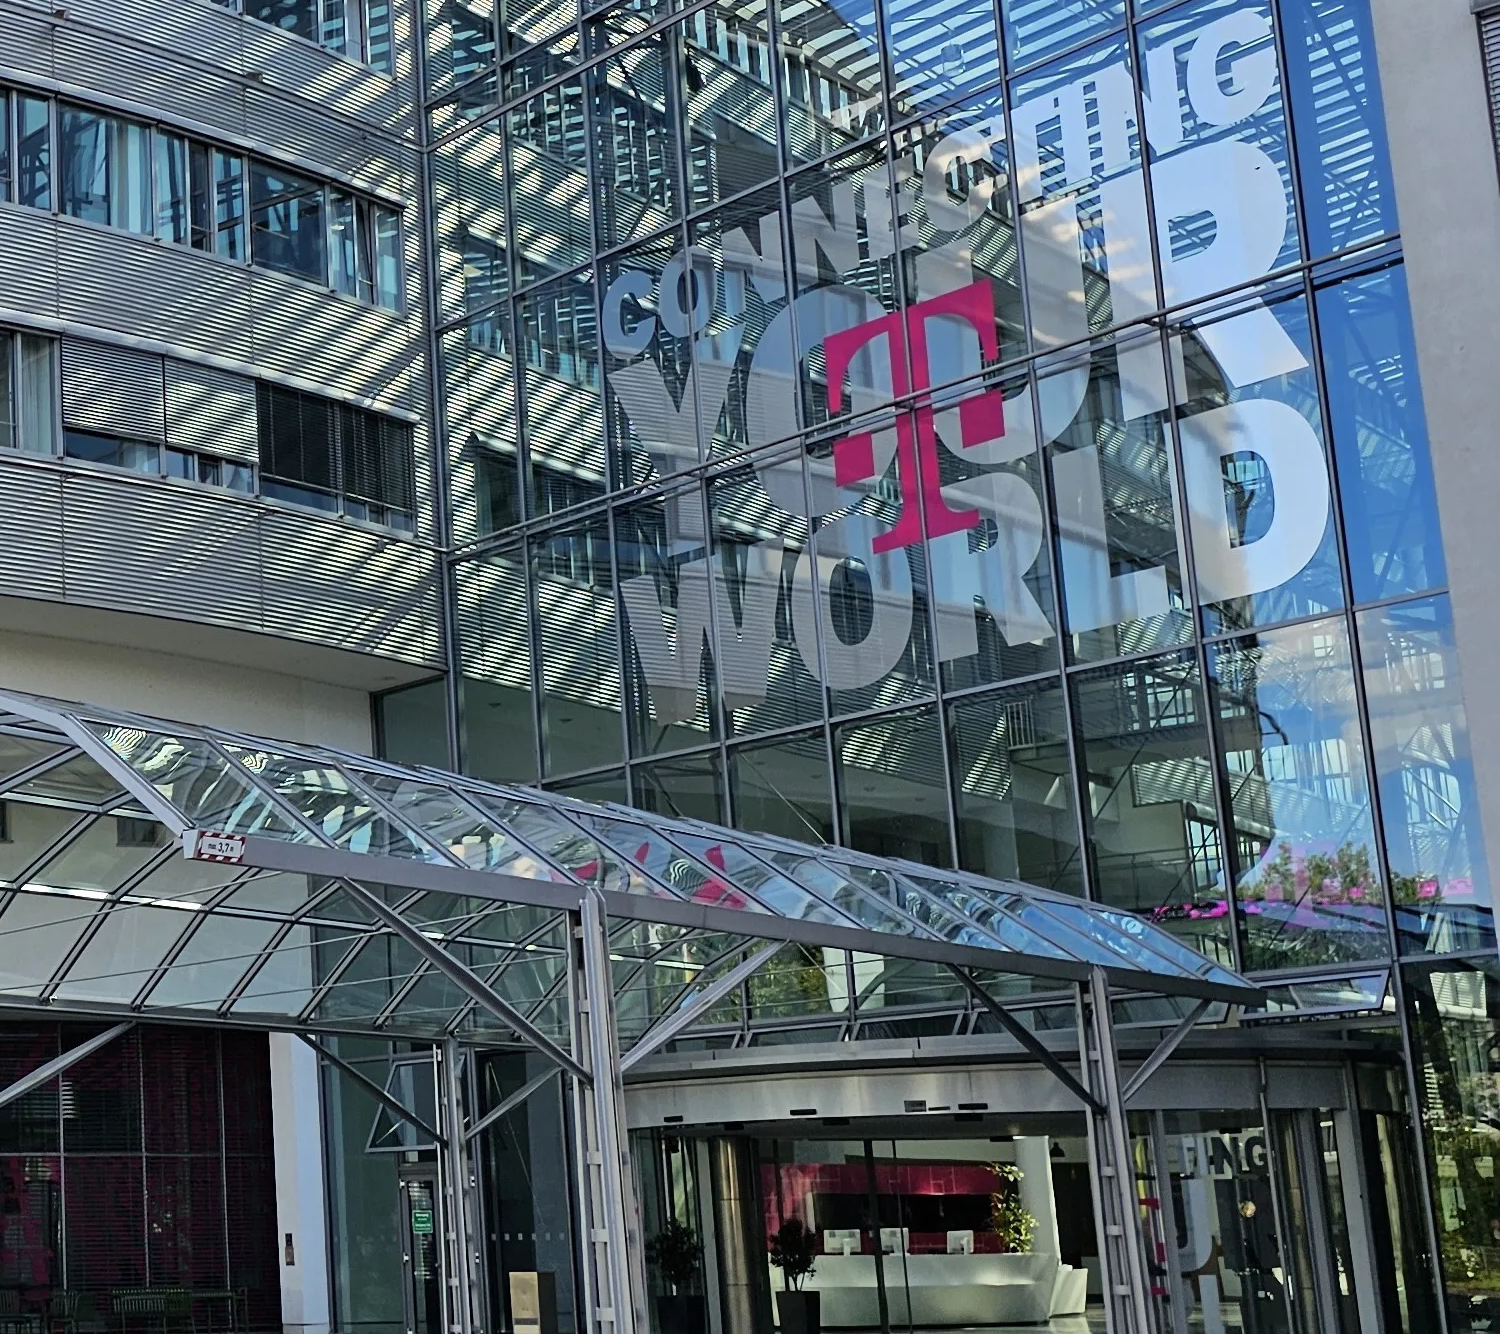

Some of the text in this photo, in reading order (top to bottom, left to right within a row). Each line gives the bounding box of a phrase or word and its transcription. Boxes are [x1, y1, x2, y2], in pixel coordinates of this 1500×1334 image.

[601, 7, 1282, 361] CONNECTING
[612, 139, 1310, 560] YOUR
[621, 397, 1330, 726] WORLD
[218, 842, 230, 854] 3,7
